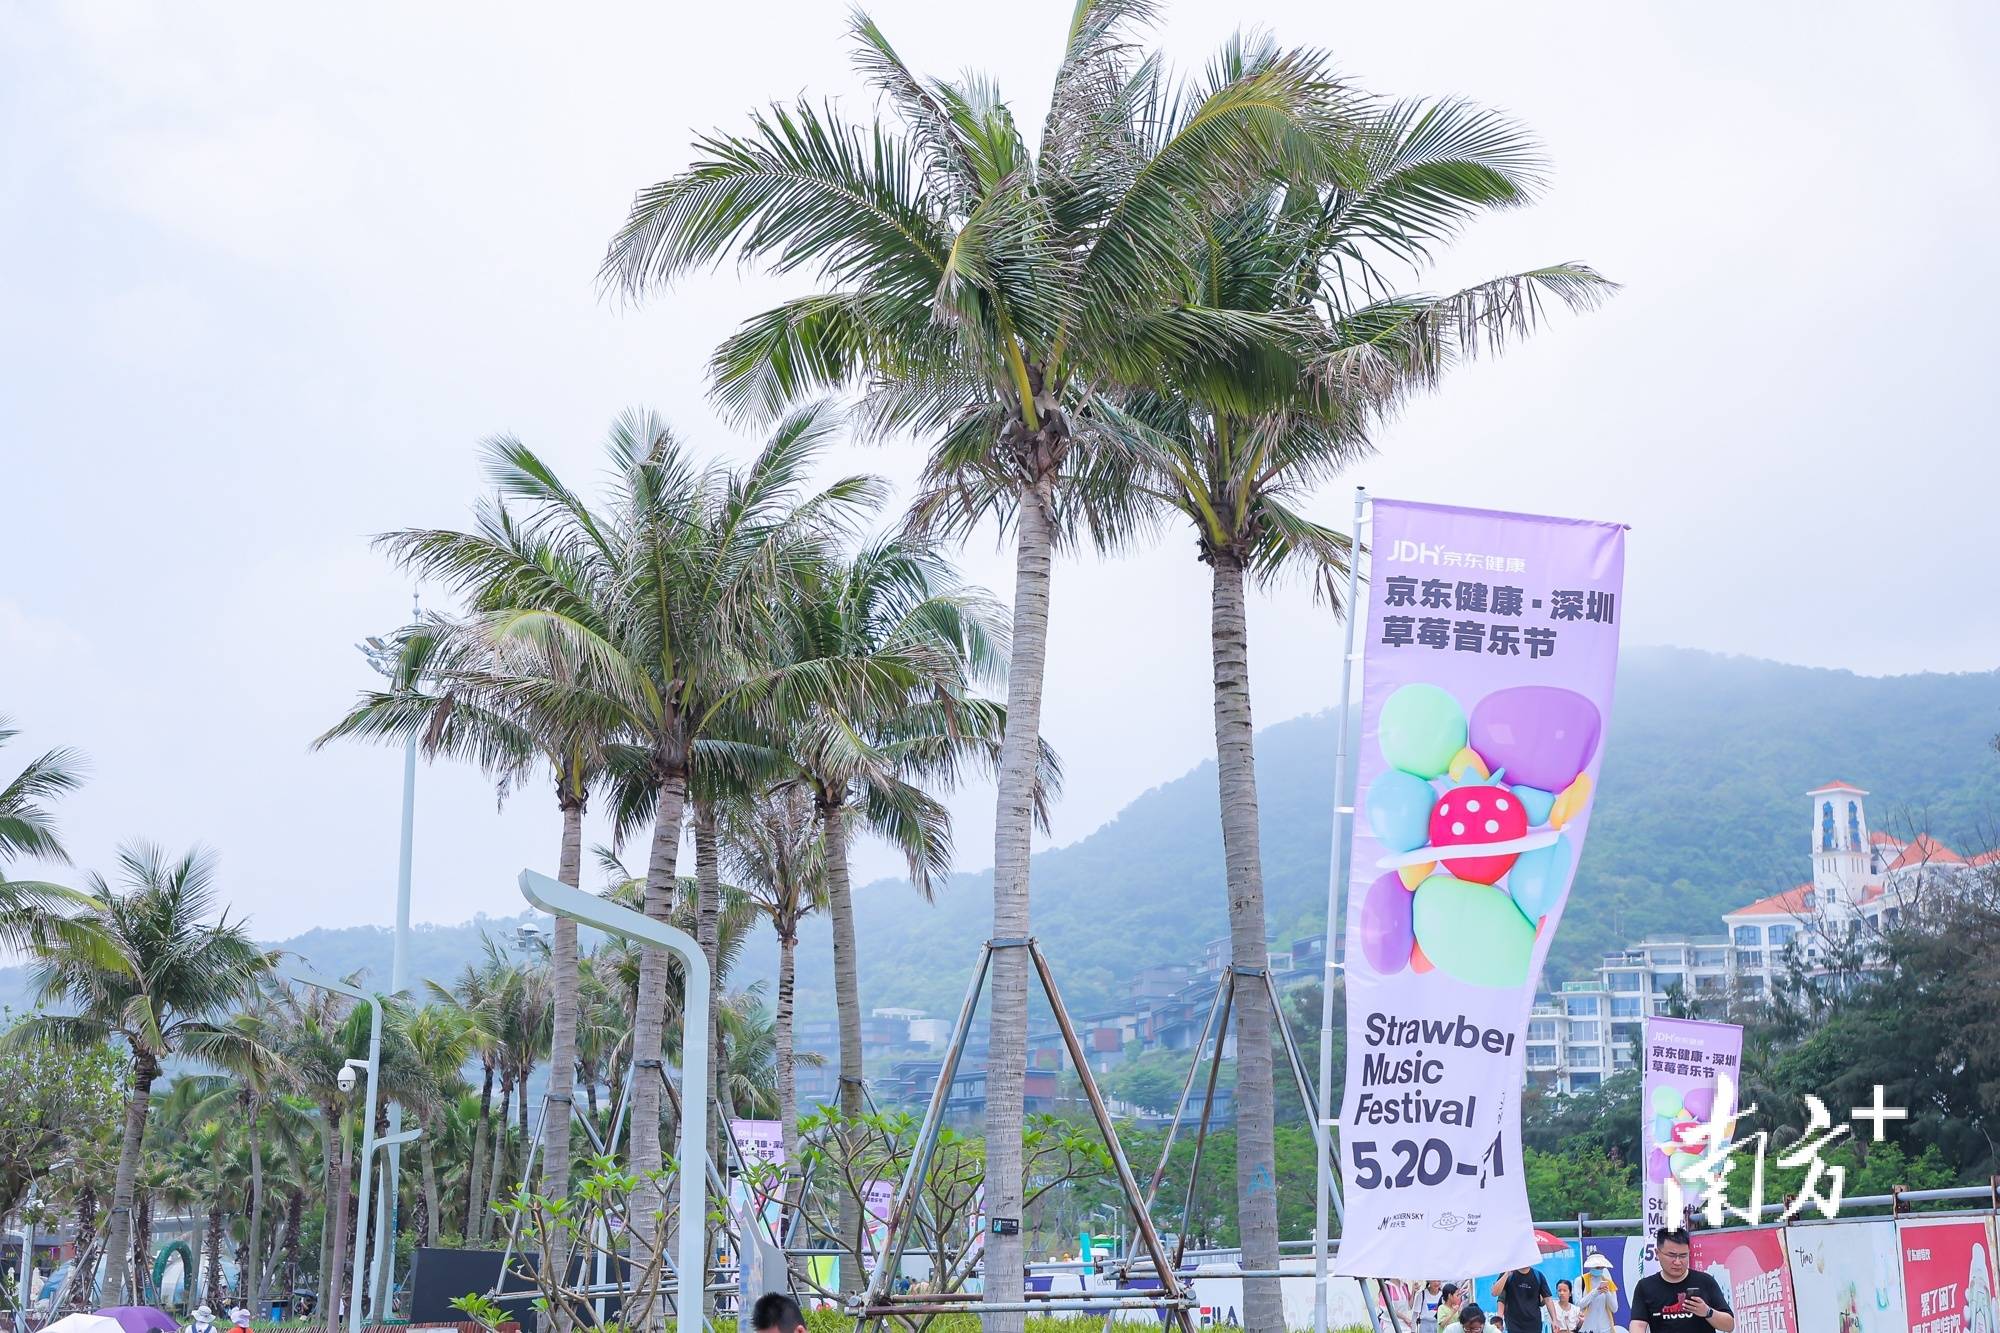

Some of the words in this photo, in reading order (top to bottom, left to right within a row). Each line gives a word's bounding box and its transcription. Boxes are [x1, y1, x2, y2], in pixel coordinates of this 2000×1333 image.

[1442, 551, 1527, 573] 京东健康
[1381, 615, 1557, 659] 草莓音乐节
[1362, 1050, 1444, 1087] Music
[1353, 1089, 1476, 1128] Festival
